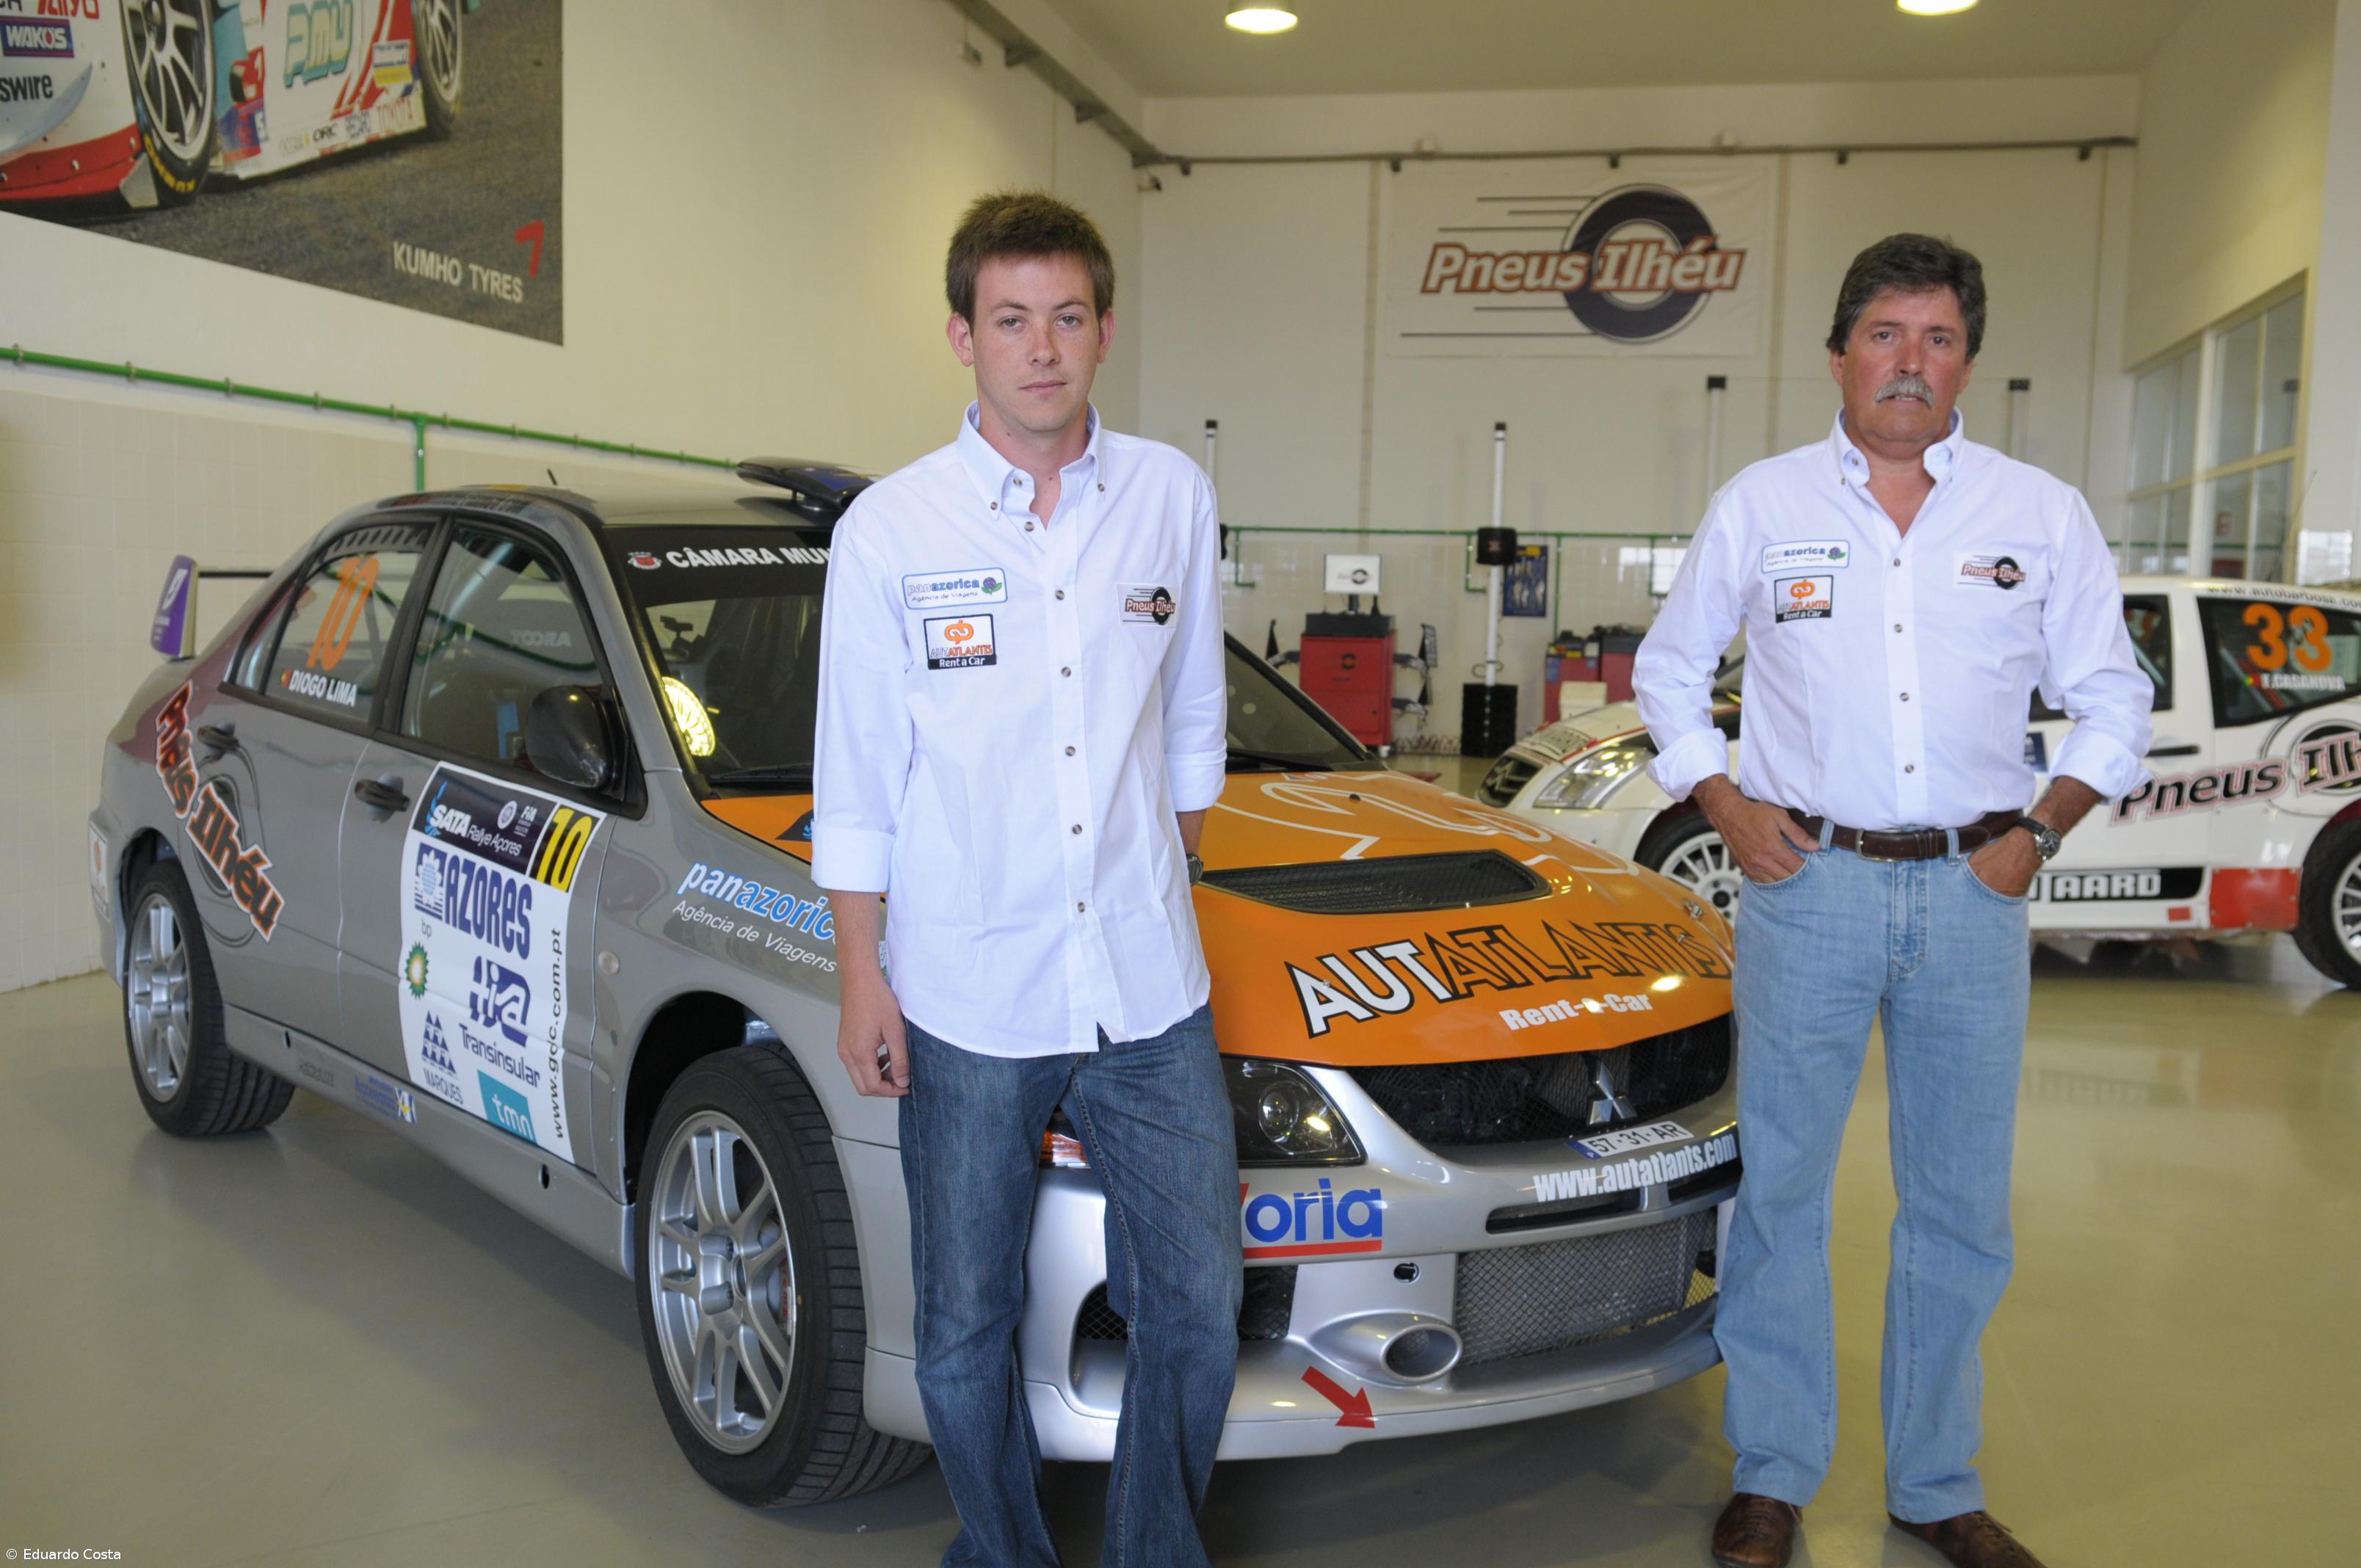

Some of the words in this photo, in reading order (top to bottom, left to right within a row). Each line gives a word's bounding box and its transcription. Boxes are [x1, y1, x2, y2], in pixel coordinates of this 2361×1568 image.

[393, 242, 463, 286] KUMHO
[468, 263, 524, 303] TYRES
[1421, 243, 1591, 293] Pneus
[1589, 235, 1747, 292] Ilhéu
[665, 546, 784, 568] CÂMARA
[1961, 563, 1998, 578] Pneus
[305, 556, 380, 671] 10
[907, 578, 980, 596] panazorica
[1125, 598, 1156, 612] Pneus
[1807, 609, 1822, 618] Car
[939, 657, 960, 668] Rent
[968, 656, 985, 667] Car
[2242, 602, 2334, 672] 33
[288, 669, 325, 697] DIOGO
[325, 678, 358, 707] LIMA
[156, 680, 199, 819] Pneus
[185, 781, 285, 943] Ilhéu
[2113, 759, 2288, 822] Pneus
[429, 803, 472, 838] SATA
[465, 824, 492, 849] Rallye
[490, 833, 523, 857] Açores
[535, 806, 593, 893] 10
[421, 918, 432, 940] bp
[675, 862, 836, 945] panazoric
[672, 899, 735, 934] Agência
[736, 925, 760, 943] de
[765, 932, 838, 973] Viagens
[458, 1023, 541, 1089] Transinsular
[548, 927, 564, 1139] www.gdc.com.pt
[423, 1067, 464, 1105] MARQUES
[491, 1093, 534, 1142] tmn
[1241, 1177, 1383, 1244] oria
